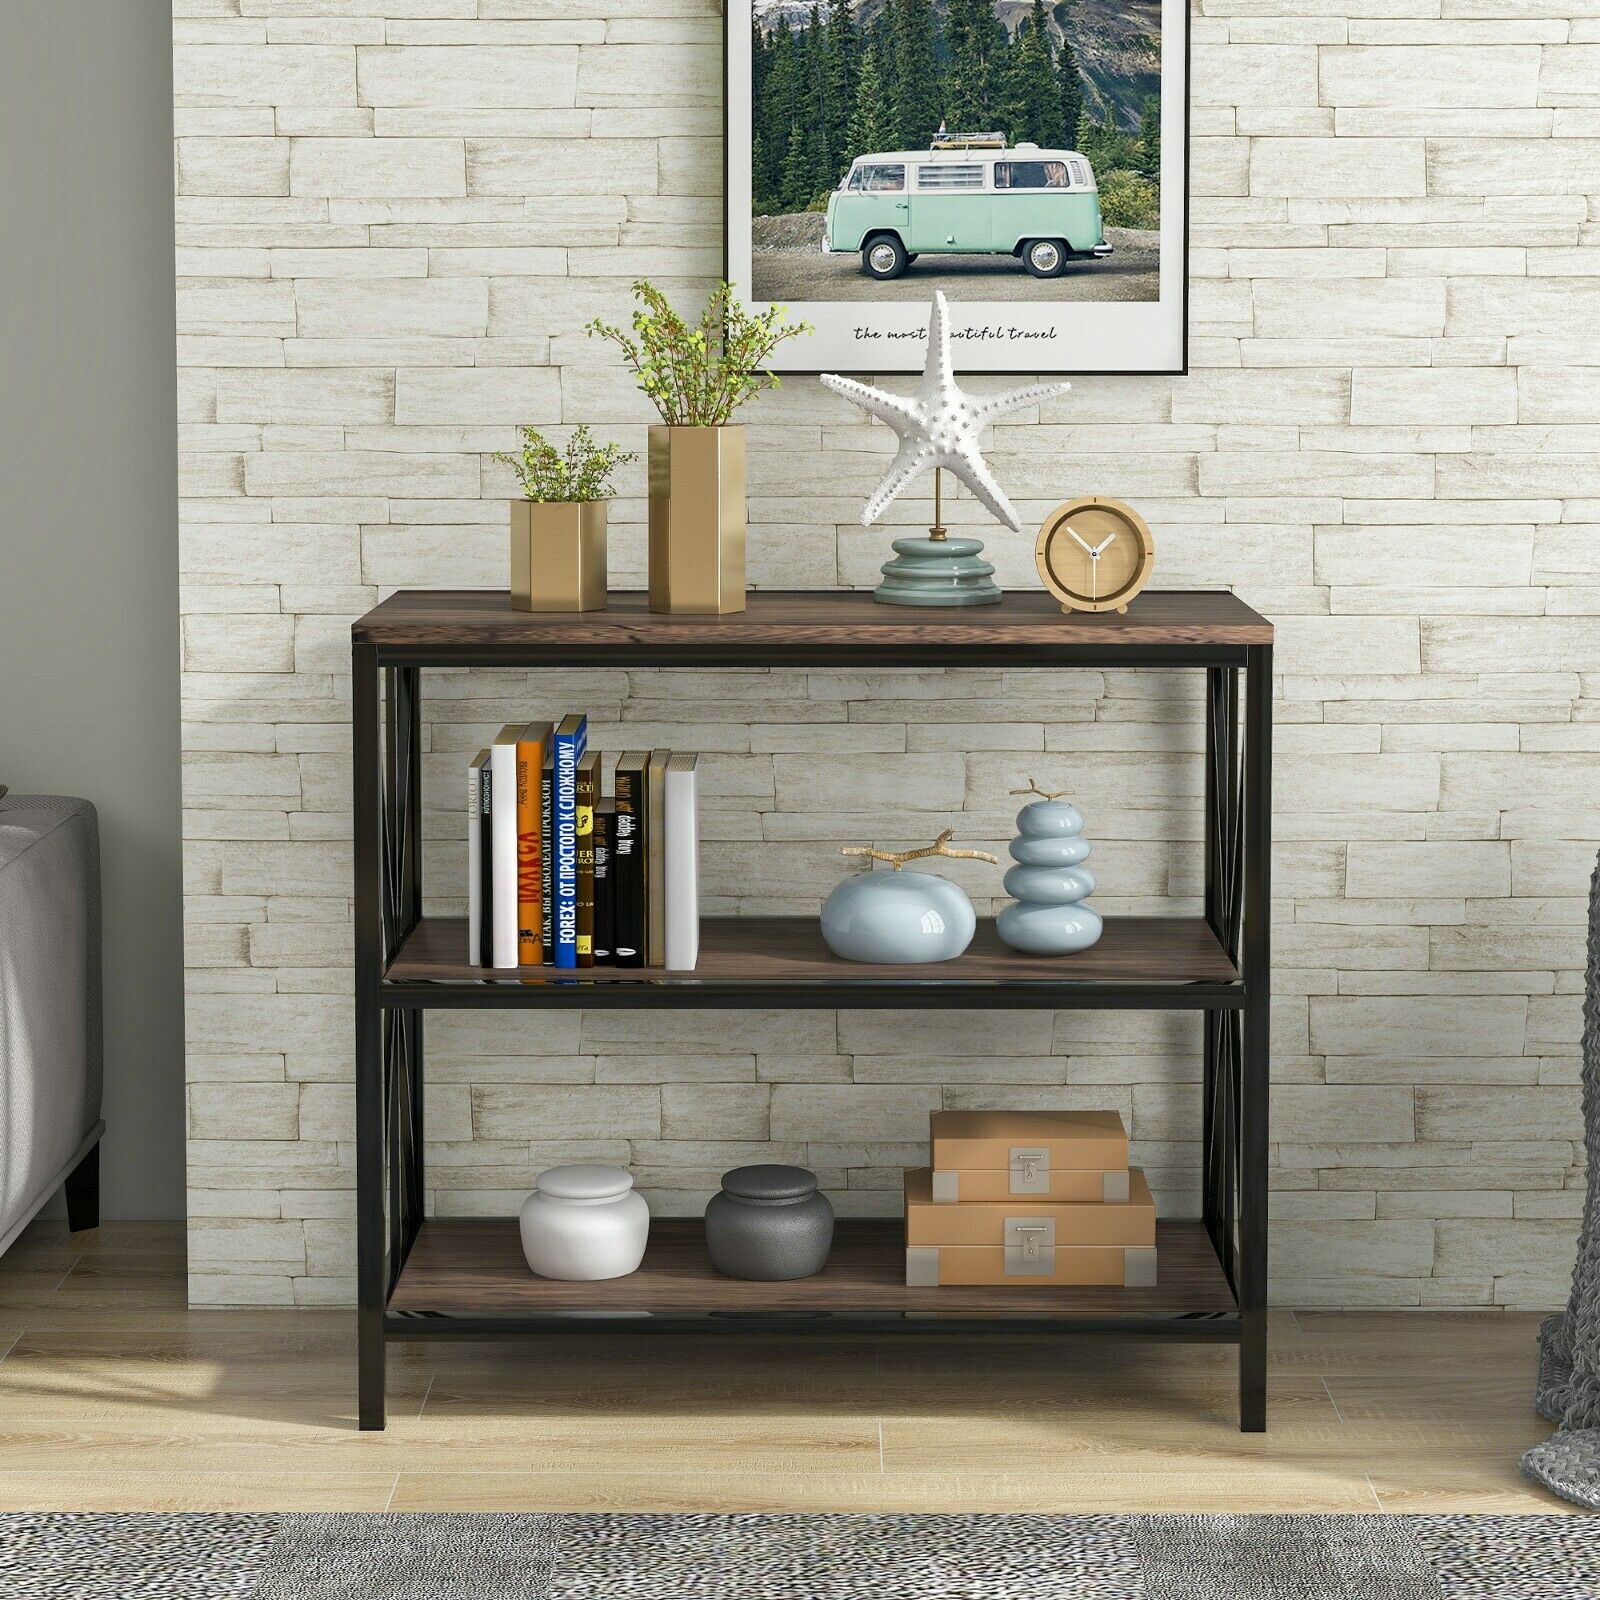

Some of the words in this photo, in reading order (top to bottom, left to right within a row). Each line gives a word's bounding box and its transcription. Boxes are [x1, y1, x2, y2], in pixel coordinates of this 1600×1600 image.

[853, 326, 881, 339] the
[887, 326, 927, 339] most
[949, 326, 1004, 341] autiful
[1007, 326, 1057, 340] travel
[559, 741, 575, 810] СЛОЖНОМУ
[559, 811, 575, 821] К
[559, 823, 575, 879] ПРОСТОГО
[559, 881, 575, 897] ОТ
[559, 901, 575, 944] FOREX:
